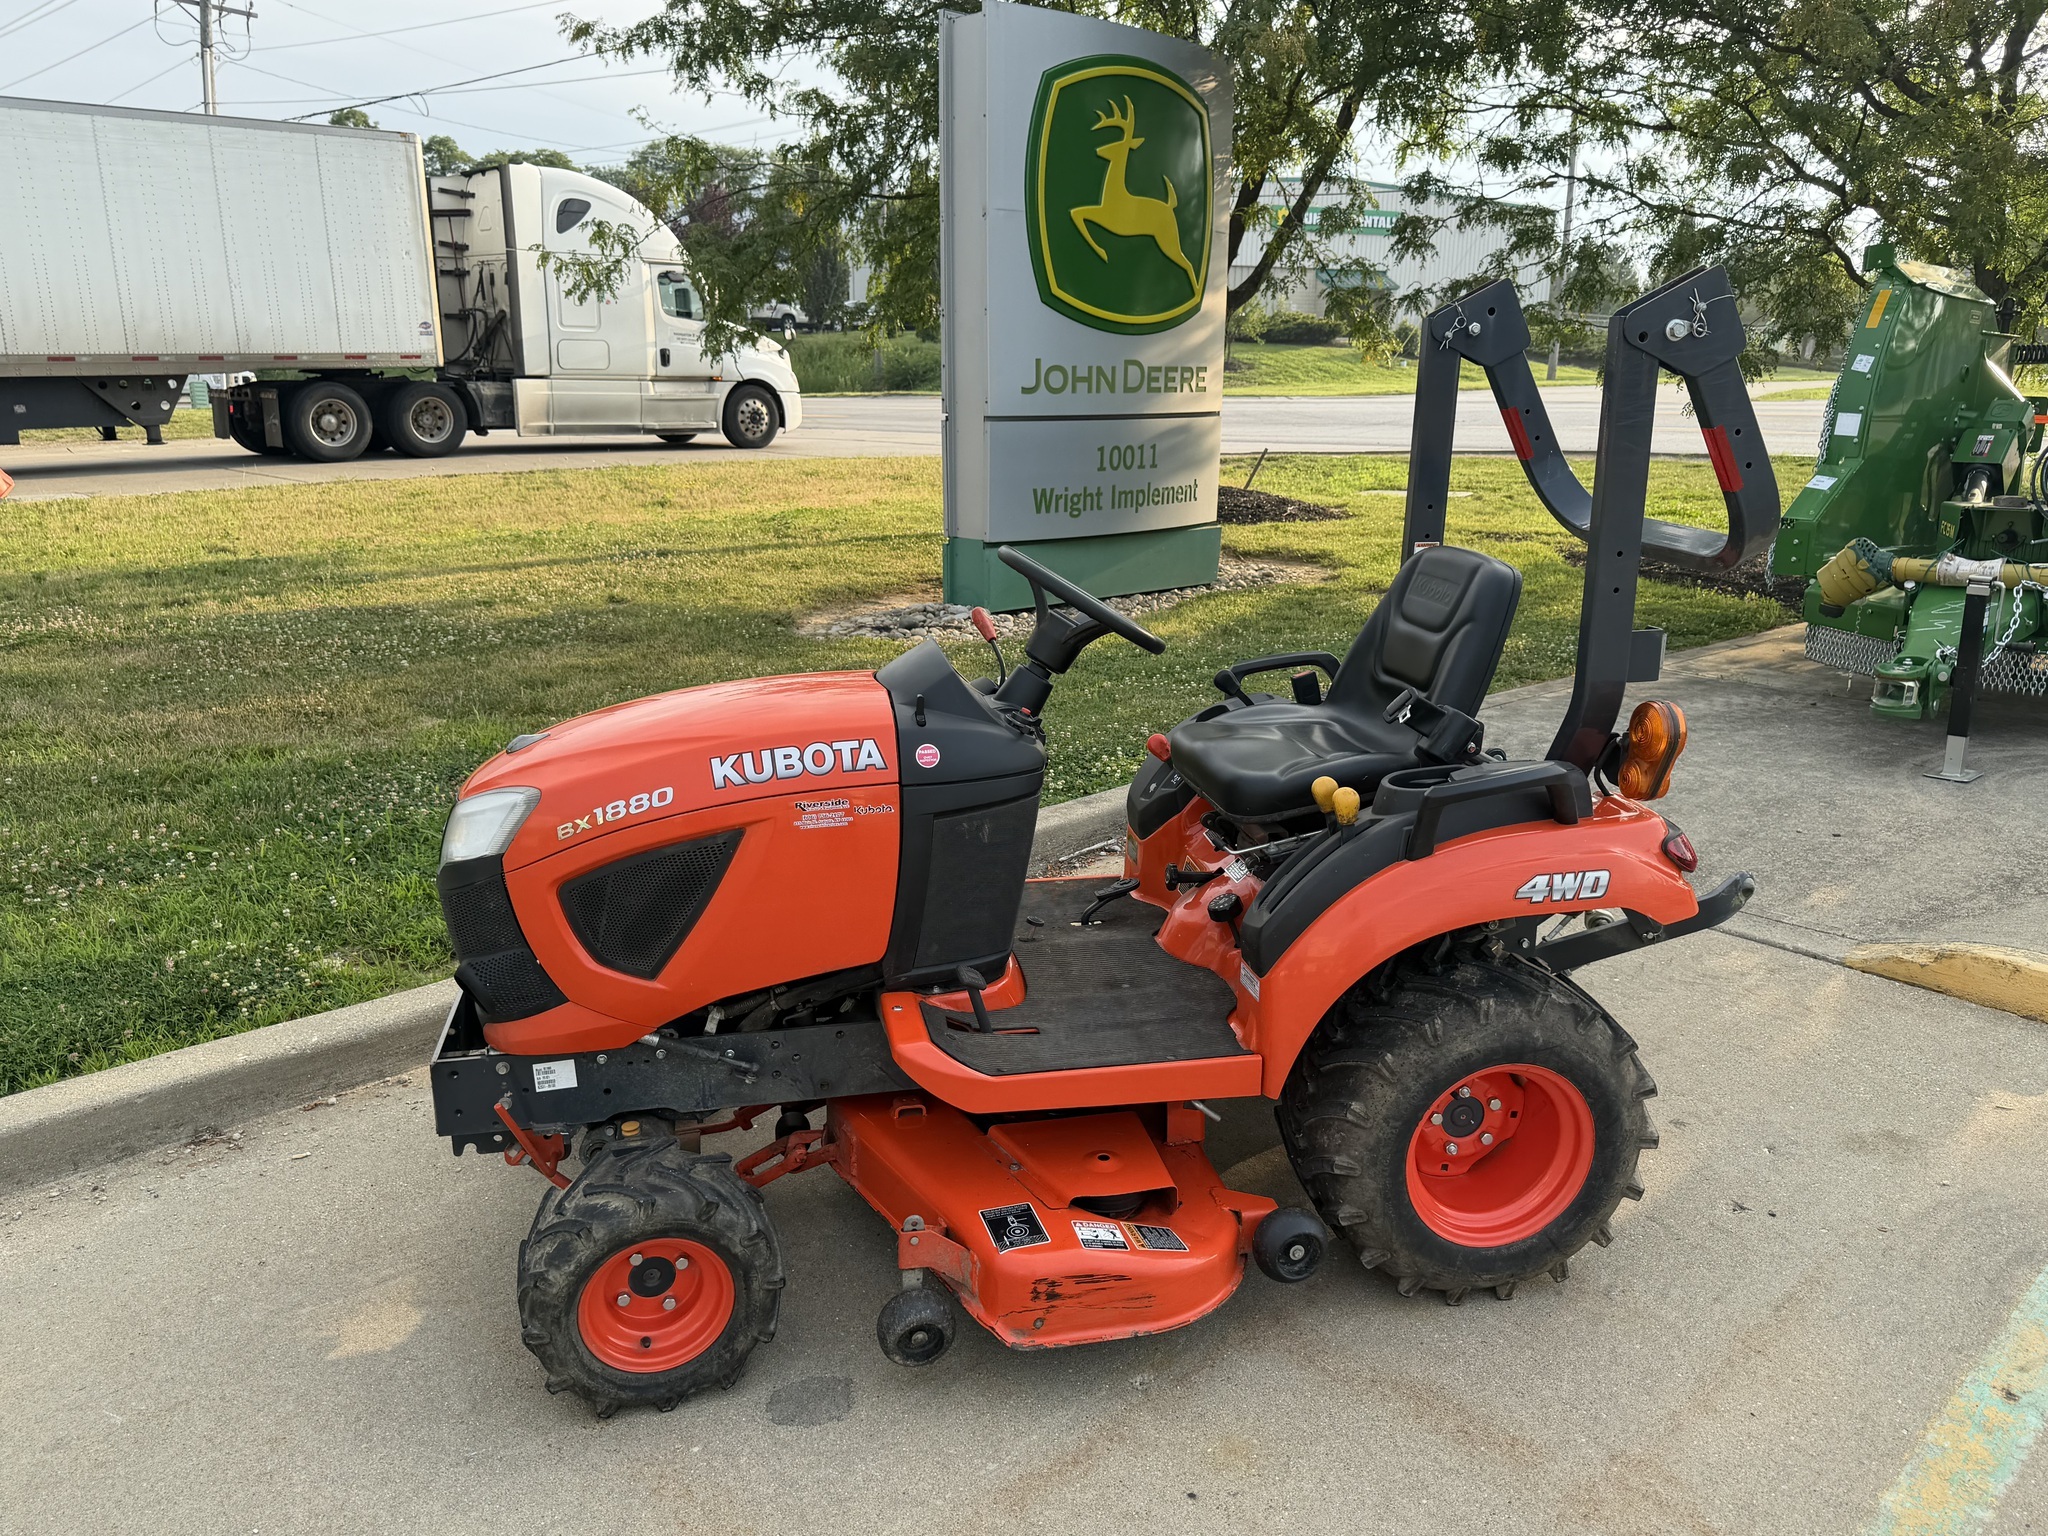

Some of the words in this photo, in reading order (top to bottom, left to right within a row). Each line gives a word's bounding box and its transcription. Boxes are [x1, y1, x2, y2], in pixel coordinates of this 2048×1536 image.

[1021, 358, 1116, 395] JOHN
[1123, 359, 1207, 394] DEERE
[1097, 443, 1158, 472] 10011
[1032, 486, 1103, 518] Wright
[1111, 478, 1198, 513] Implement
[709, 738, 888, 790] KUBOTA
[795, 798, 849, 812] Riverside
[854, 804, 893, 815] Kubota
[1514, 869, 1612, 904] 4WD
[1083, 1222, 1117, 1230] DANGER
